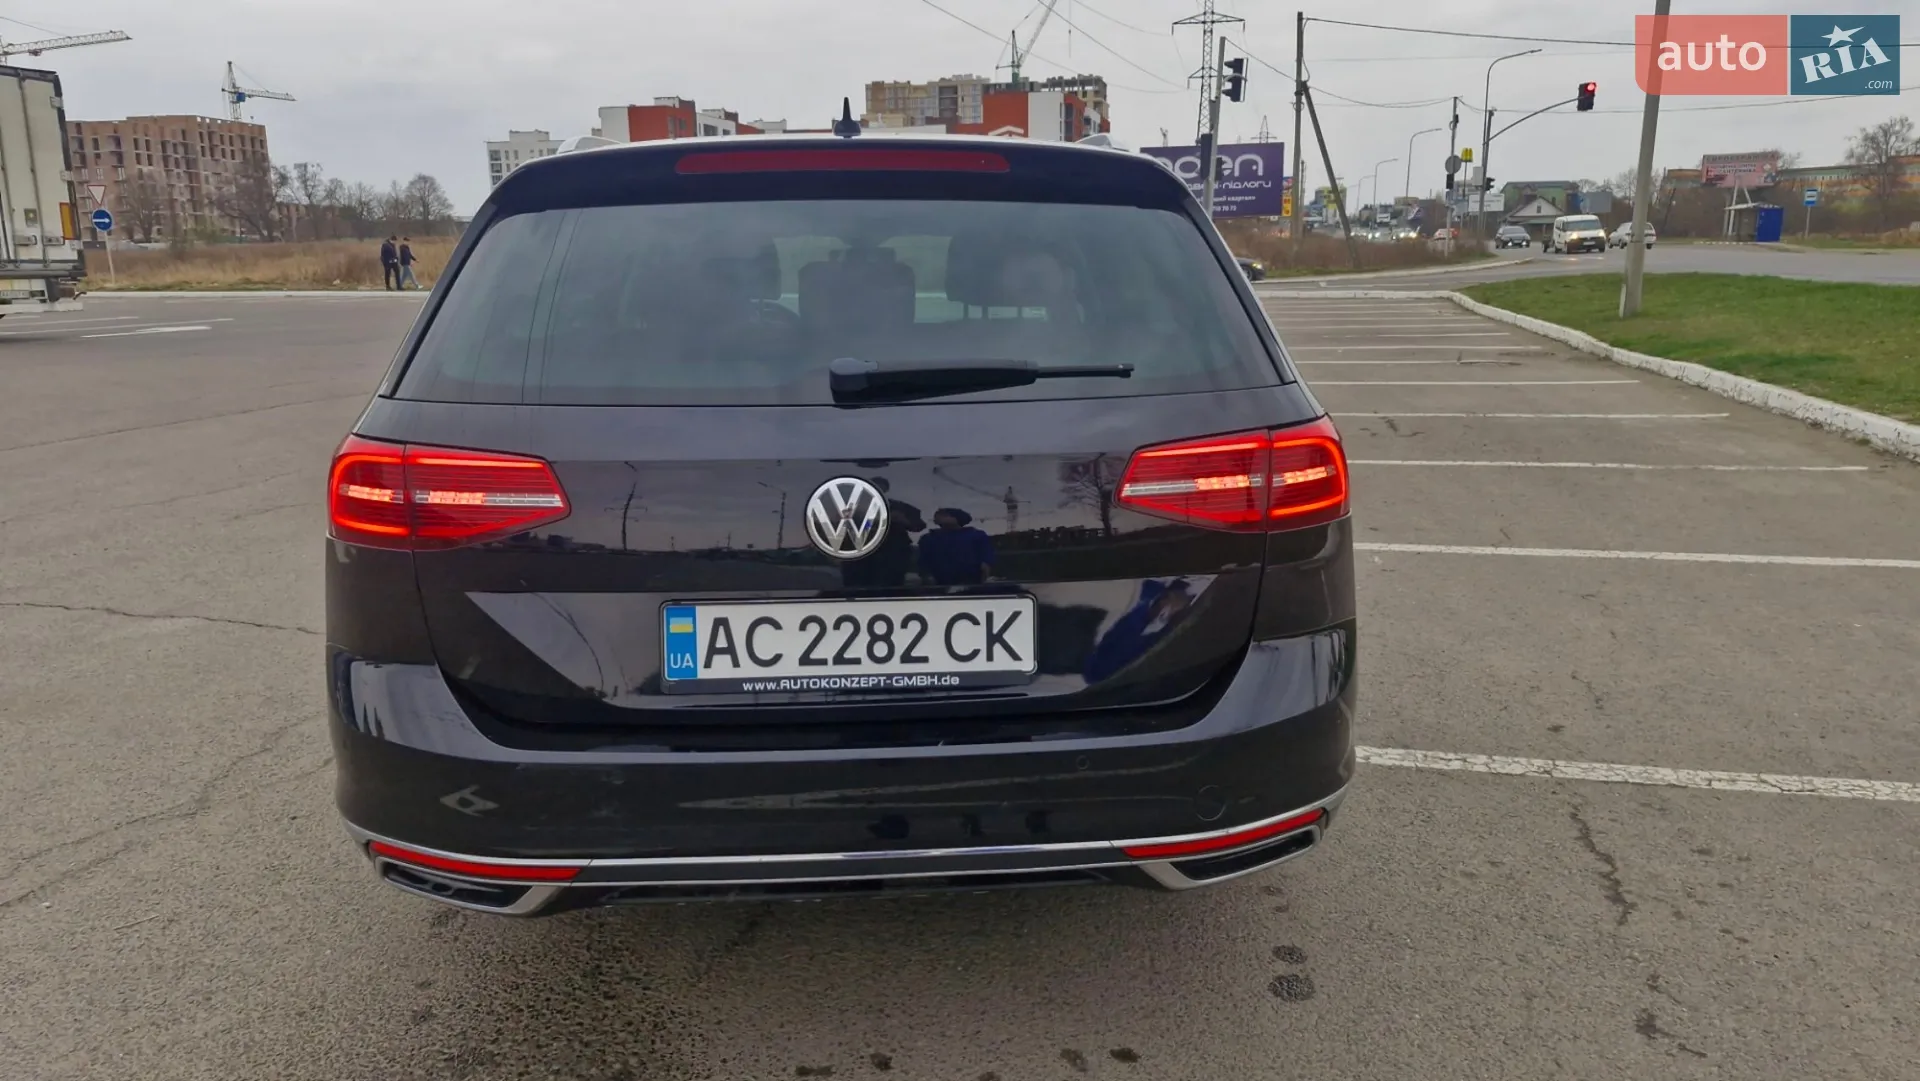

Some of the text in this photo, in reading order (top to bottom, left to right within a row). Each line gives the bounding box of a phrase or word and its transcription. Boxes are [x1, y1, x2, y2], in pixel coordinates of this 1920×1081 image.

[703, 610, 1023, 669] AC 2282 CK
[670, 653, 694, 669] UA
[742, 675, 960, 692] www.AUTOKONZEPT-GMBH.de
